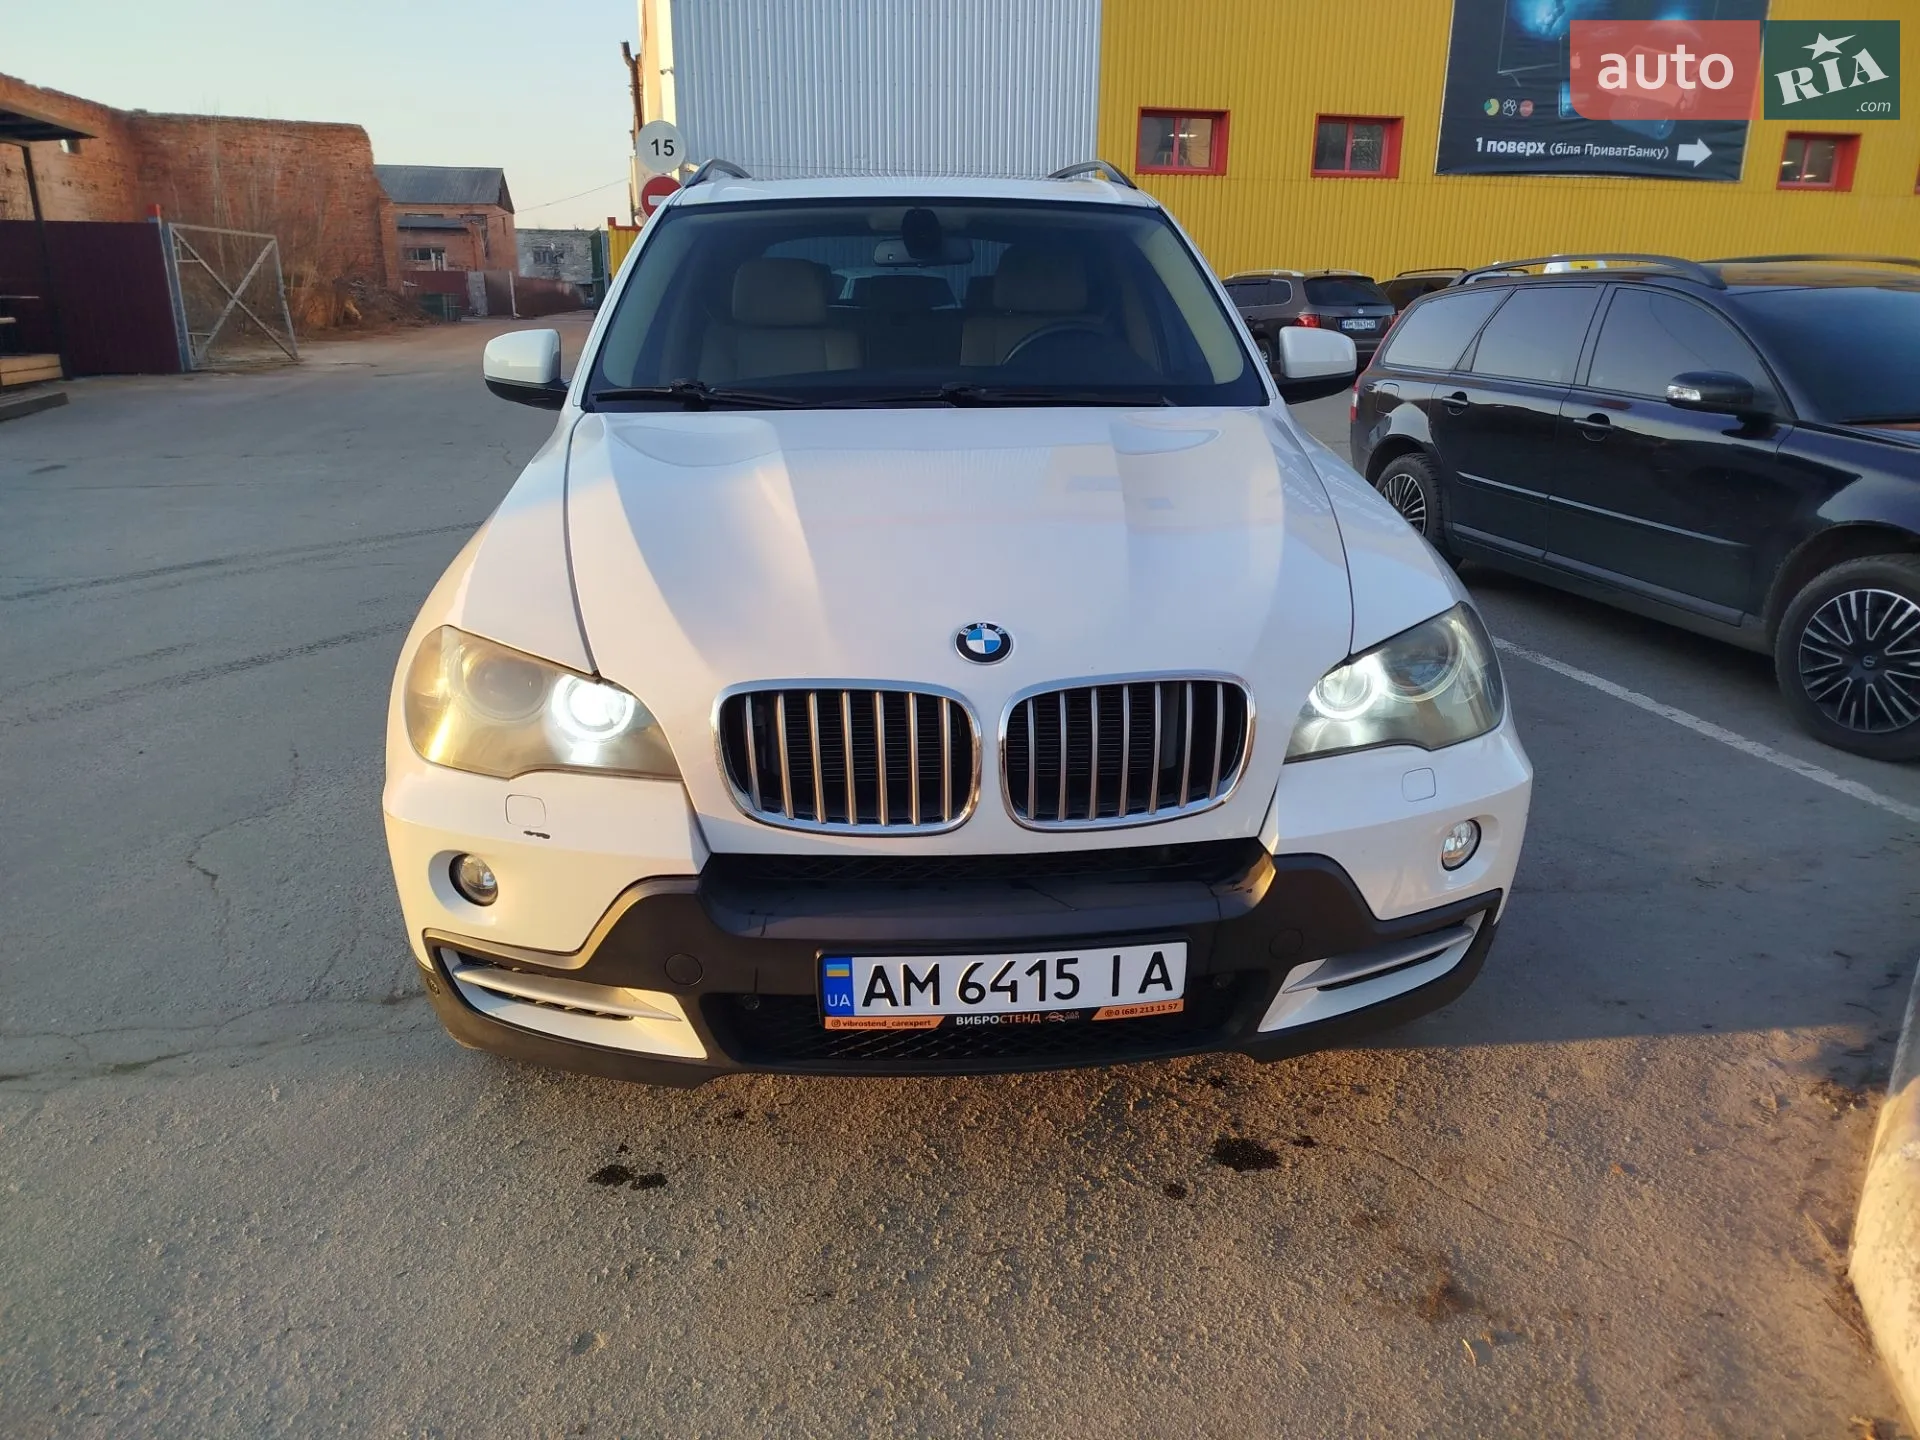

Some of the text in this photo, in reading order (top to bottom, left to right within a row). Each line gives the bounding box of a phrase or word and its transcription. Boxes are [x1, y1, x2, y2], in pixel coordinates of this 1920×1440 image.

[650, 138, 675, 157] 15
[1475, 136, 1669, 160] 1 поверх (біля ПриватБанку)
[960, 623, 1006, 636] BMW
[861, 962, 941, 1008] AM
[957, 957, 1081, 1005] 6415
[827, 994, 852, 1007] UA
[1122, 1008, 1138, 1016] (68)
[1139, 1006, 1155, 1014] 213
[842, 1019, 932, 1029] vibrostend_carexpert
[956, 1013, 1041, 1026] ВИБРОСТЕНД
